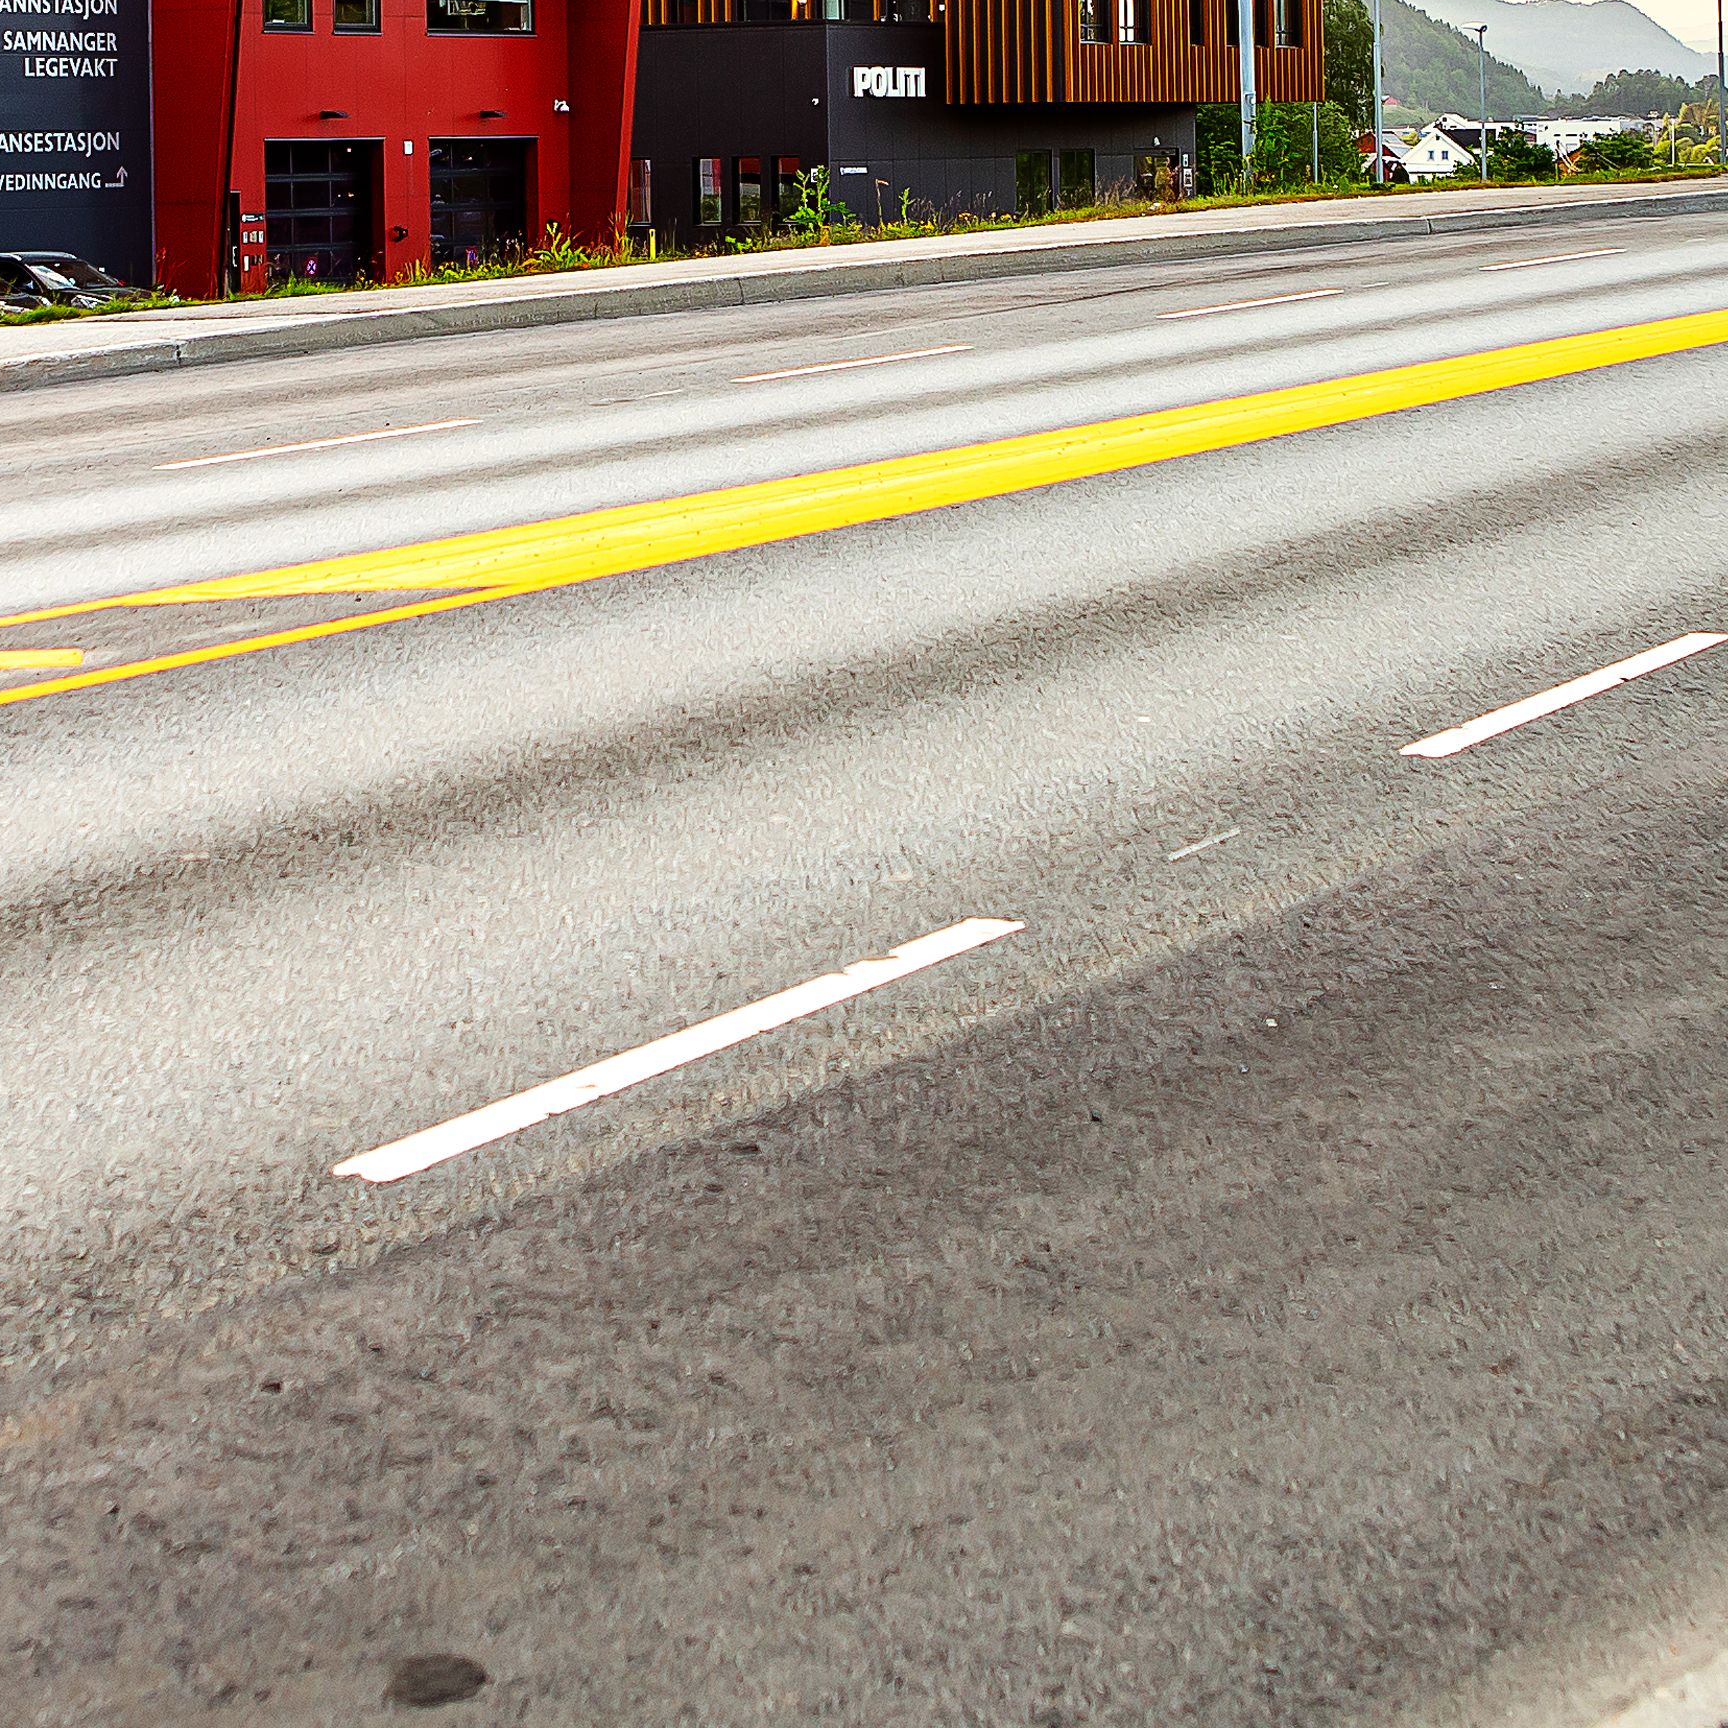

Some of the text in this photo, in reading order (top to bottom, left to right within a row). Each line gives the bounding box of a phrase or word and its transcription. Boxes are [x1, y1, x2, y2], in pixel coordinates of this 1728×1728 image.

[3, 30, 118, 52] SAMNANGER
[24, 57, 118, 77] LEGEVAKT
[853, 66, 926, 97] POLITI
